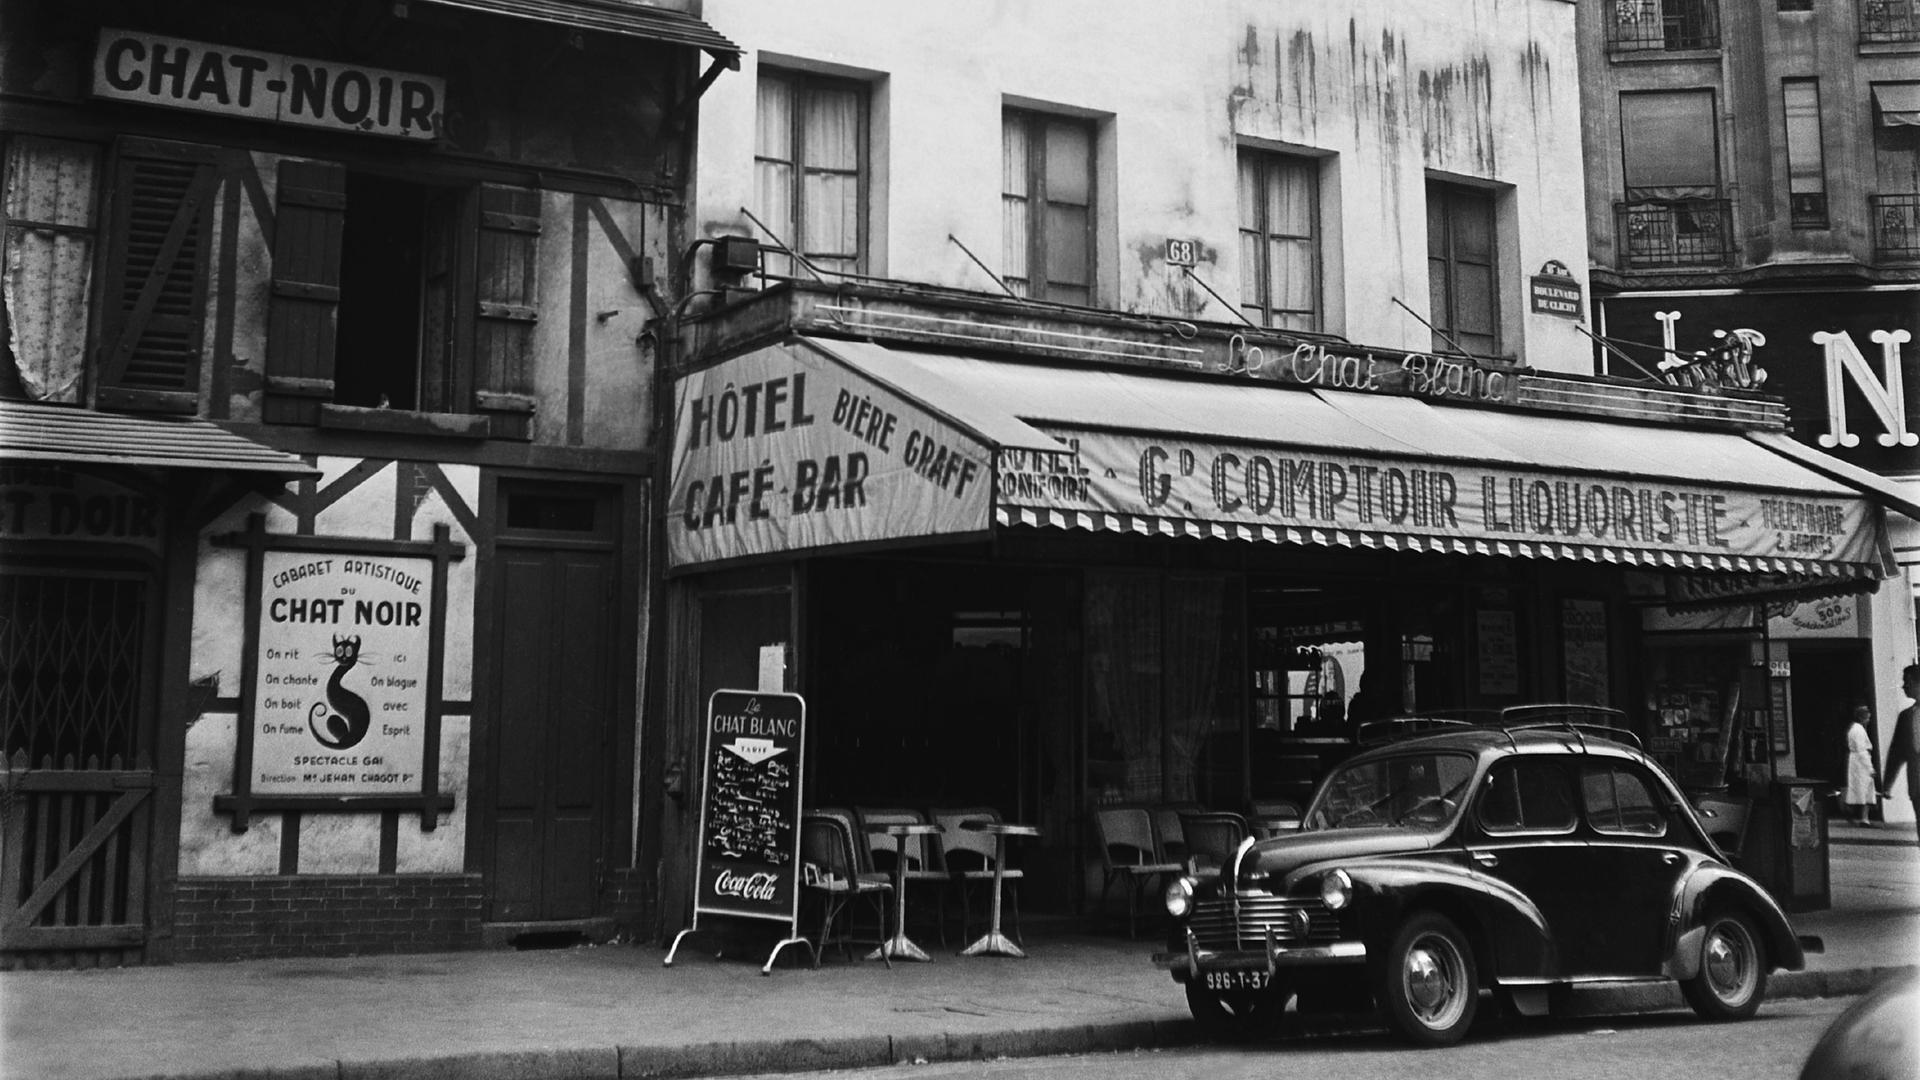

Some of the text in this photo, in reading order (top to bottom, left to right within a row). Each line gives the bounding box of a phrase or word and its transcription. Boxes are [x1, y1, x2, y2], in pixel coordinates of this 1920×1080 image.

[104, 37, 433, 132] CHAT-NOIR
[1170, 241, 1191, 261] 68
[1534, 286, 1579, 301] BOULEVARD
[1538, 299, 1577, 313] DE CLICHY
[1218, 334, 1504, 401] Le Chat Blanc
[690, 371, 815, 451] HÔTEL
[832, 387, 978, 499] BIÈRE GRAFF
[683, 451, 870, 532] CAFÉ BAR
[997, 472, 1091, 502] ONFORT
[1211, 452, 1459, 529] COMPTOIR
[1481, 475, 1729, 547] LIQUORISTE
[272, 560, 422, 595] CABARET ARTISTIQUE
[340, 587, 356, 596] DU
[270, 598, 422, 627] CHAT NOIR
[266, 649, 299, 660] On rit
[265, 673, 318, 686] On chante
[370, 676, 417, 690] On blague
[264, 698, 302, 709] On boit
[383, 702, 408, 711] avec
[744, 697, 761, 715] Le
[262, 723, 304, 734] On fume
[382, 724, 411, 738] Esprit
[713, 714, 797, 738] CHAT BLANC
[293, 755, 383, 766] SPECTACLE GAI
[261, 773, 296, 783] Direction
[319, 773, 355, 783] JEHAN
[361, 773, 399, 783] CHAGOT
